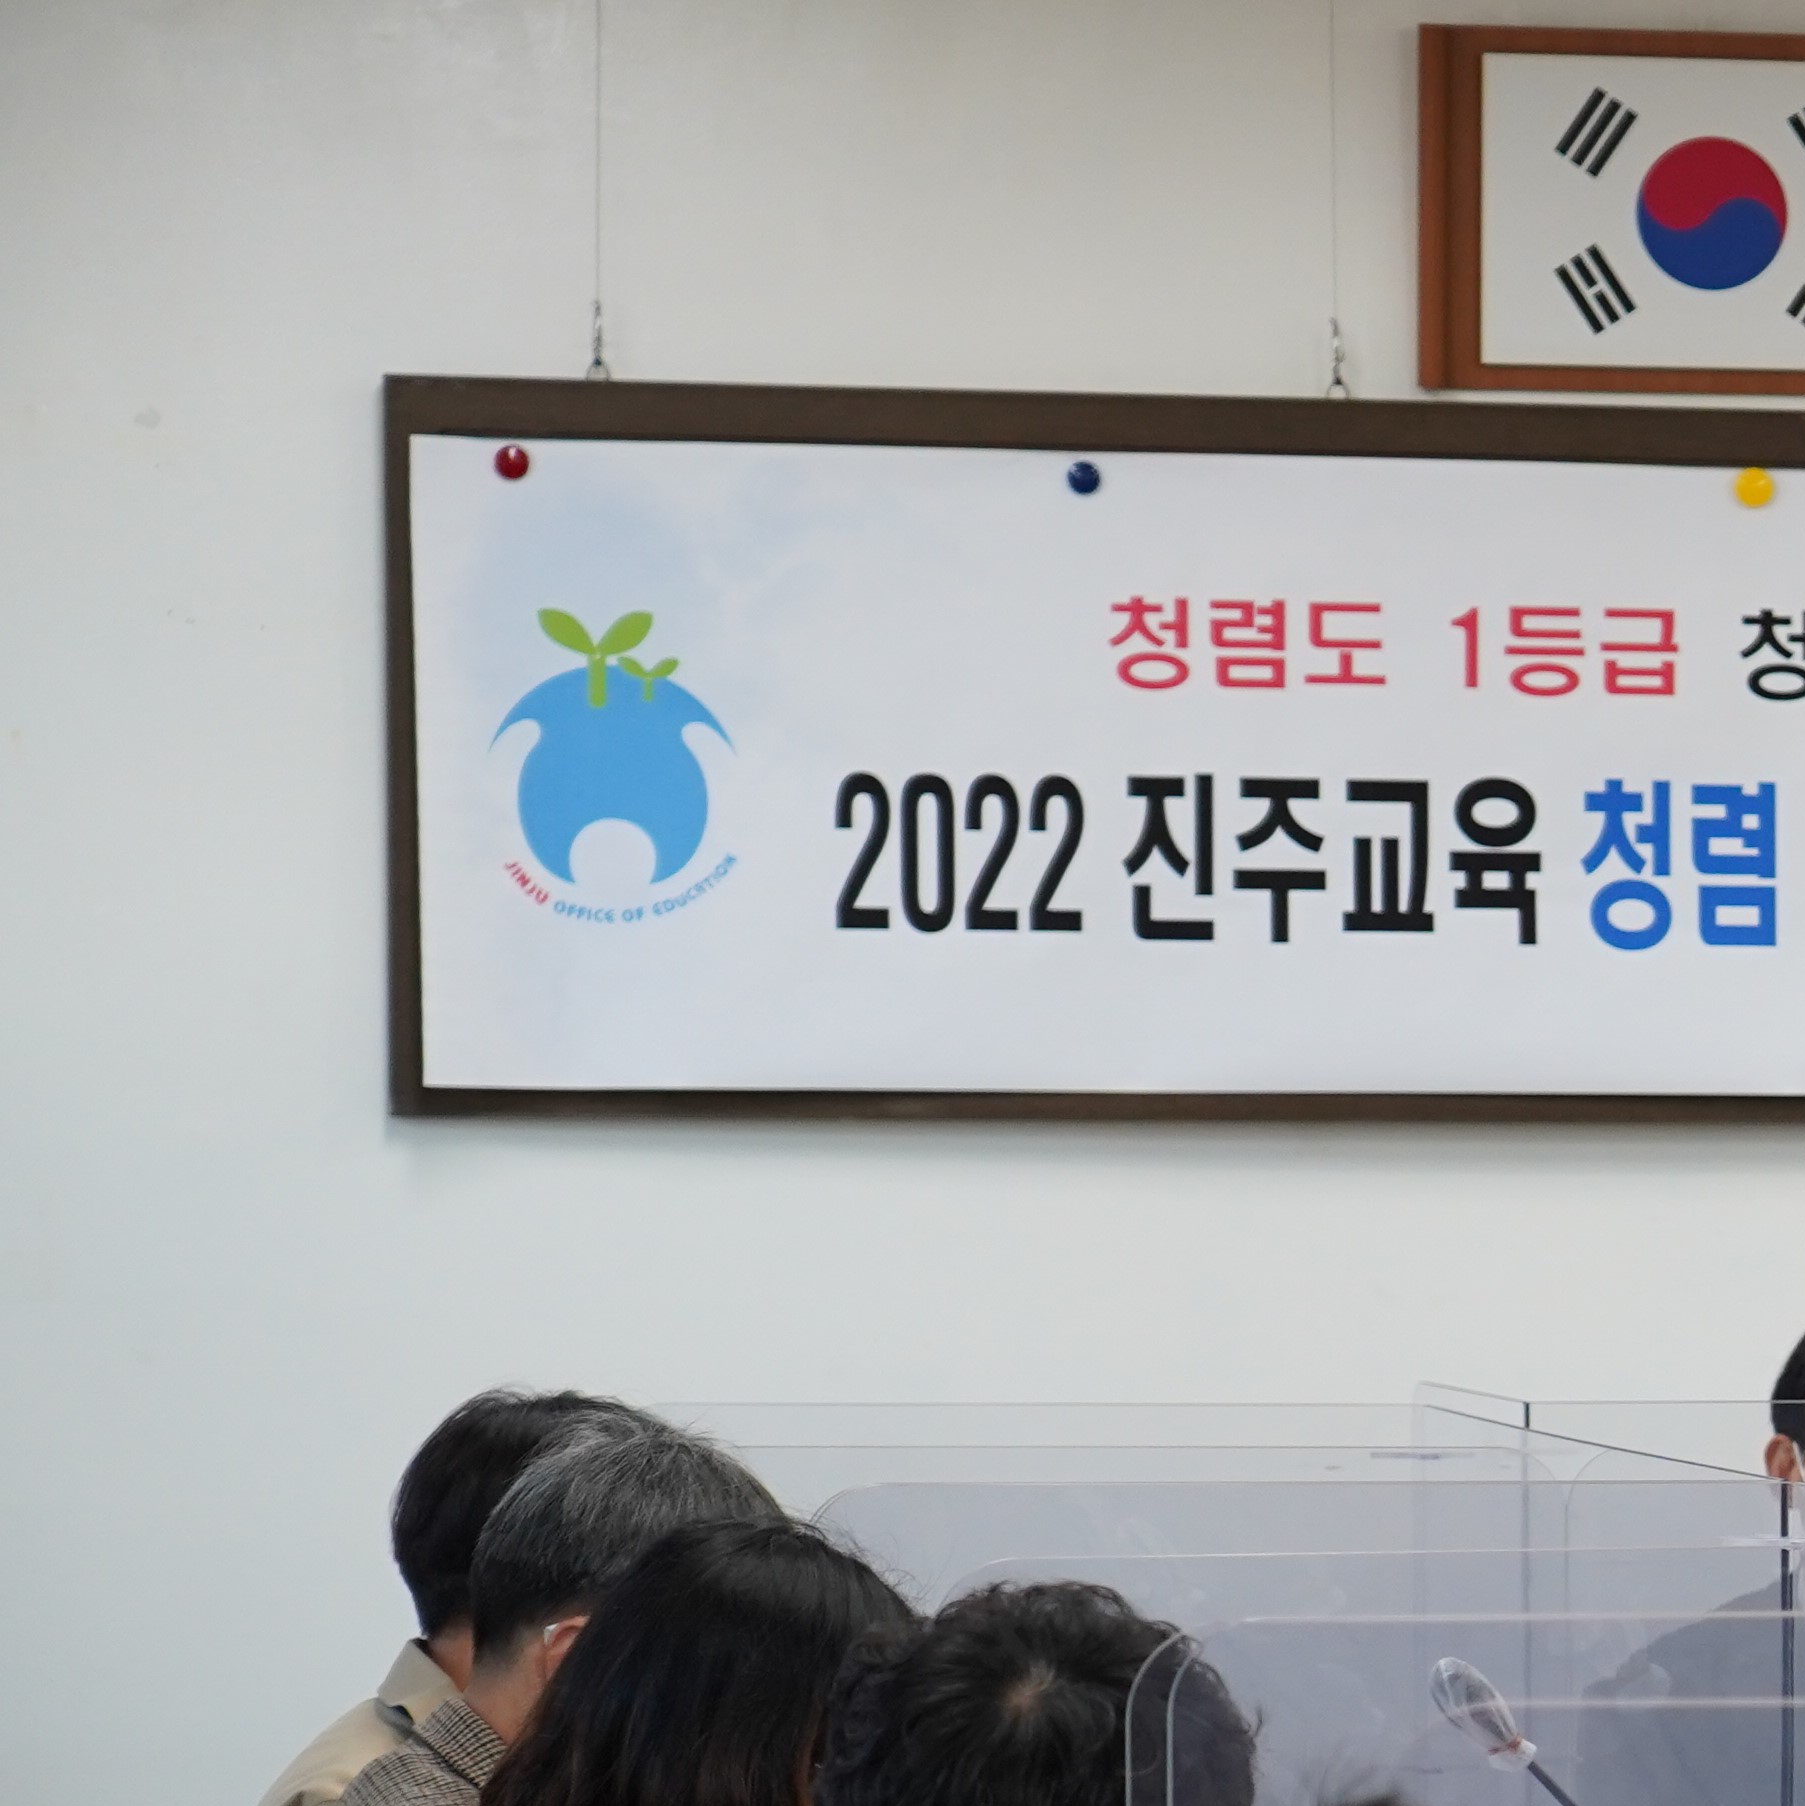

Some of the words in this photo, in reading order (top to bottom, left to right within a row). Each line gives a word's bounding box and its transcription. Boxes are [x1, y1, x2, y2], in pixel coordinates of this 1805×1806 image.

[1110, 596, 1387, 691] 청렴도
[1450, 606, 1680, 697] 1등급
[503, 860, 550, 906] JINJU
[552, 899, 616, 924] OFFICE
[621, 905, 645, 923] OF
[651, 852, 738, 917] EDUCATION
[834, 771, 1085, 932] 2022
[1123, 773, 1542, 945] 진주교육
[1579, 777, 1779, 952] 청렴
